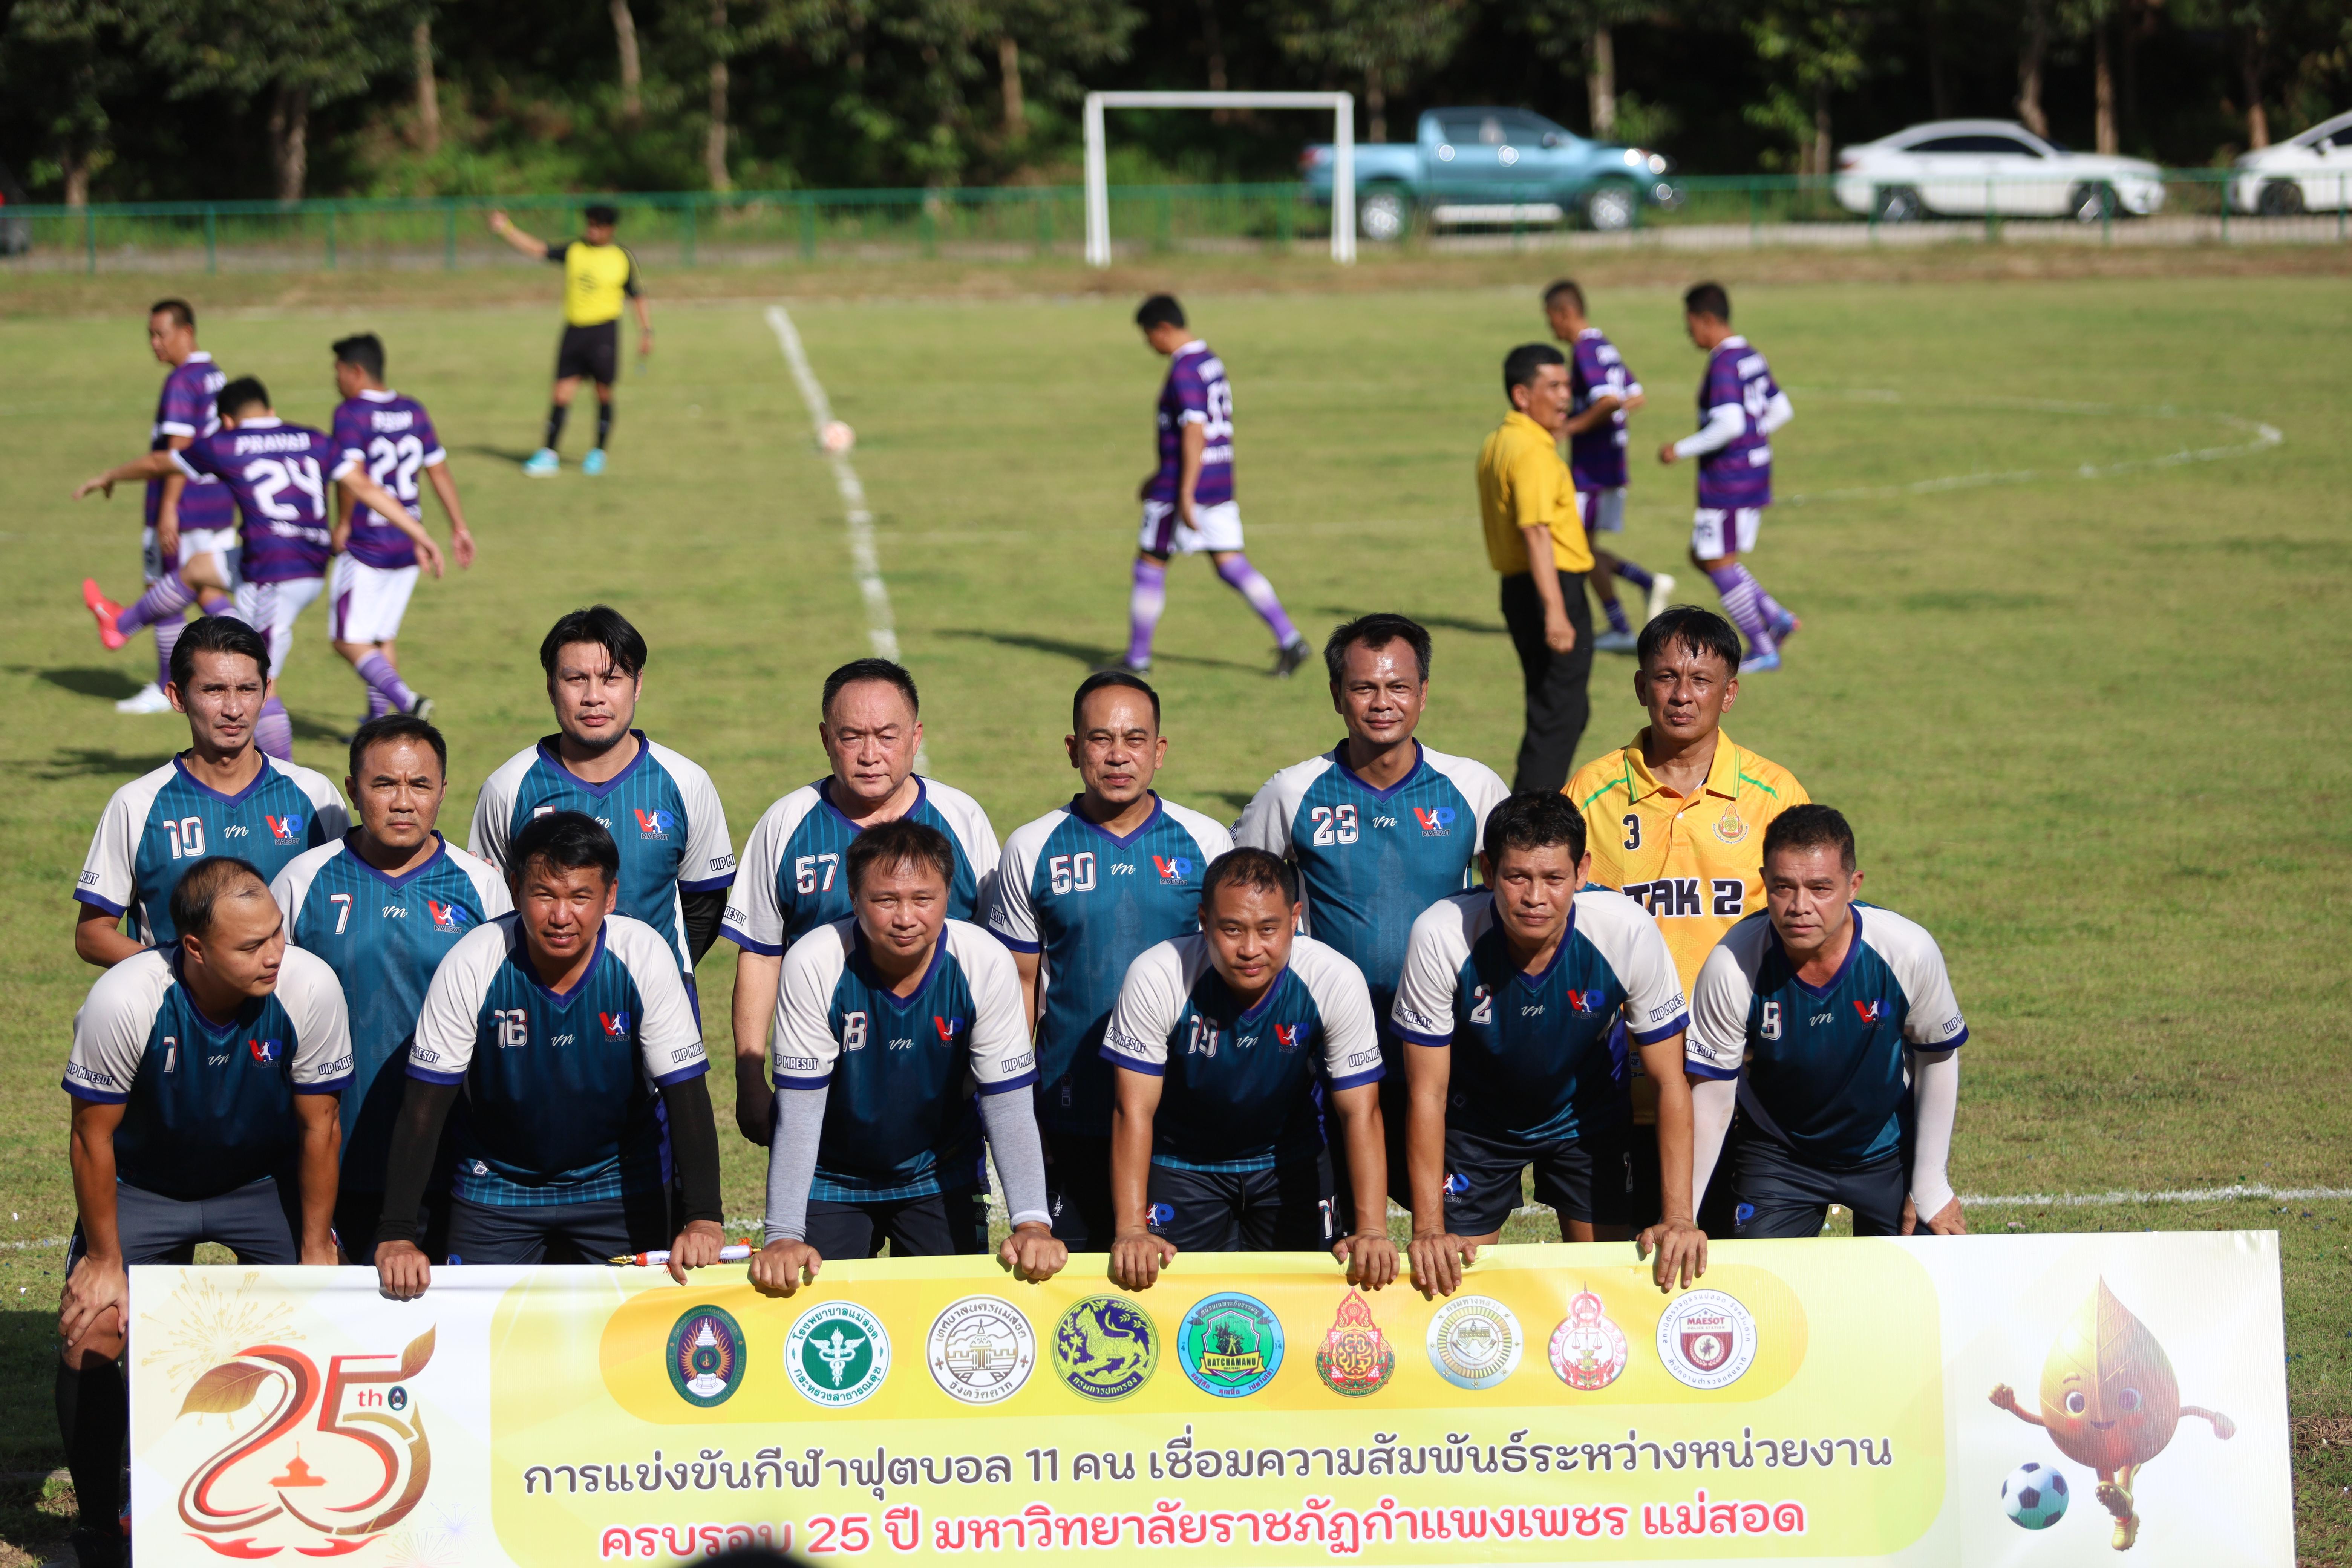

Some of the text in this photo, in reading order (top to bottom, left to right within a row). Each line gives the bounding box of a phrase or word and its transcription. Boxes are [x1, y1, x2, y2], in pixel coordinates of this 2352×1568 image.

[243, 455, 327, 521] 24
[163, 815, 206, 859] 10
[1311, 804, 1359, 846] 23
[1623, 814, 1641, 851] 3
[80, 870, 99, 885] AESOT
[710, 858, 725, 872] VIP
[795, 853, 839, 895] 57
[1049, 851, 1096, 896] 50
[1159, 877, 1188, 886] MAESOT
[1622, 878, 1744, 917] TAK 2
[330, 893, 352, 934] 7
[724, 906, 747, 926] AESOT
[991, 907, 1006, 925] ESOT
[434, 925, 462, 934] MAESOT
[1470, 983, 1493, 1024] 2
[1571, 1011, 1600, 1019] MAESOT
[1650, 992, 1686, 1023] VIP MAES
[494, 1008, 528, 1049] 16
[1760, 1000, 1782, 1040] 8
[1943, 1018, 1956, 1034] VIP
[252, 1060, 280, 1069] MAESOT
[318, 1053, 352, 1075] VIP MAES
[673, 1042, 704, 1063] VIP MAES
[783, 1056, 819, 1070] MAESOT
[1002, 1051, 1034, 1073] VIP MAES
[1349, 1054, 1365, 1068] VIP
[77, 1067, 114, 1086] MAESOT
[792, 1307, 879, 1340] โรงพยาบาลแม่สอด
[1207, 1358, 1256, 1366] RATCHAMANU
[794, 1366, 882, 1401] กระทรวงสาธารณสุข
[1073, 1377, 1138, 1395] กรมการปกครอง
[178, 1344, 431, 1534] 25 th
[526, 1424, 1891, 1500] การแข่งขันกีฬาฟุตบอล 11 คน เชื่อมความสัมพันธ์ระหว่างหน่วยงาน
[808, 1516, 870, 1554] 25
[885, 1507, 919, 1551] ปี
[936, 1497, 1630, 1553] มหาวิทยาลัยราชภัฏกำแพงเพชร
[1644, 1490, 1806, 1536] แม่สอด
